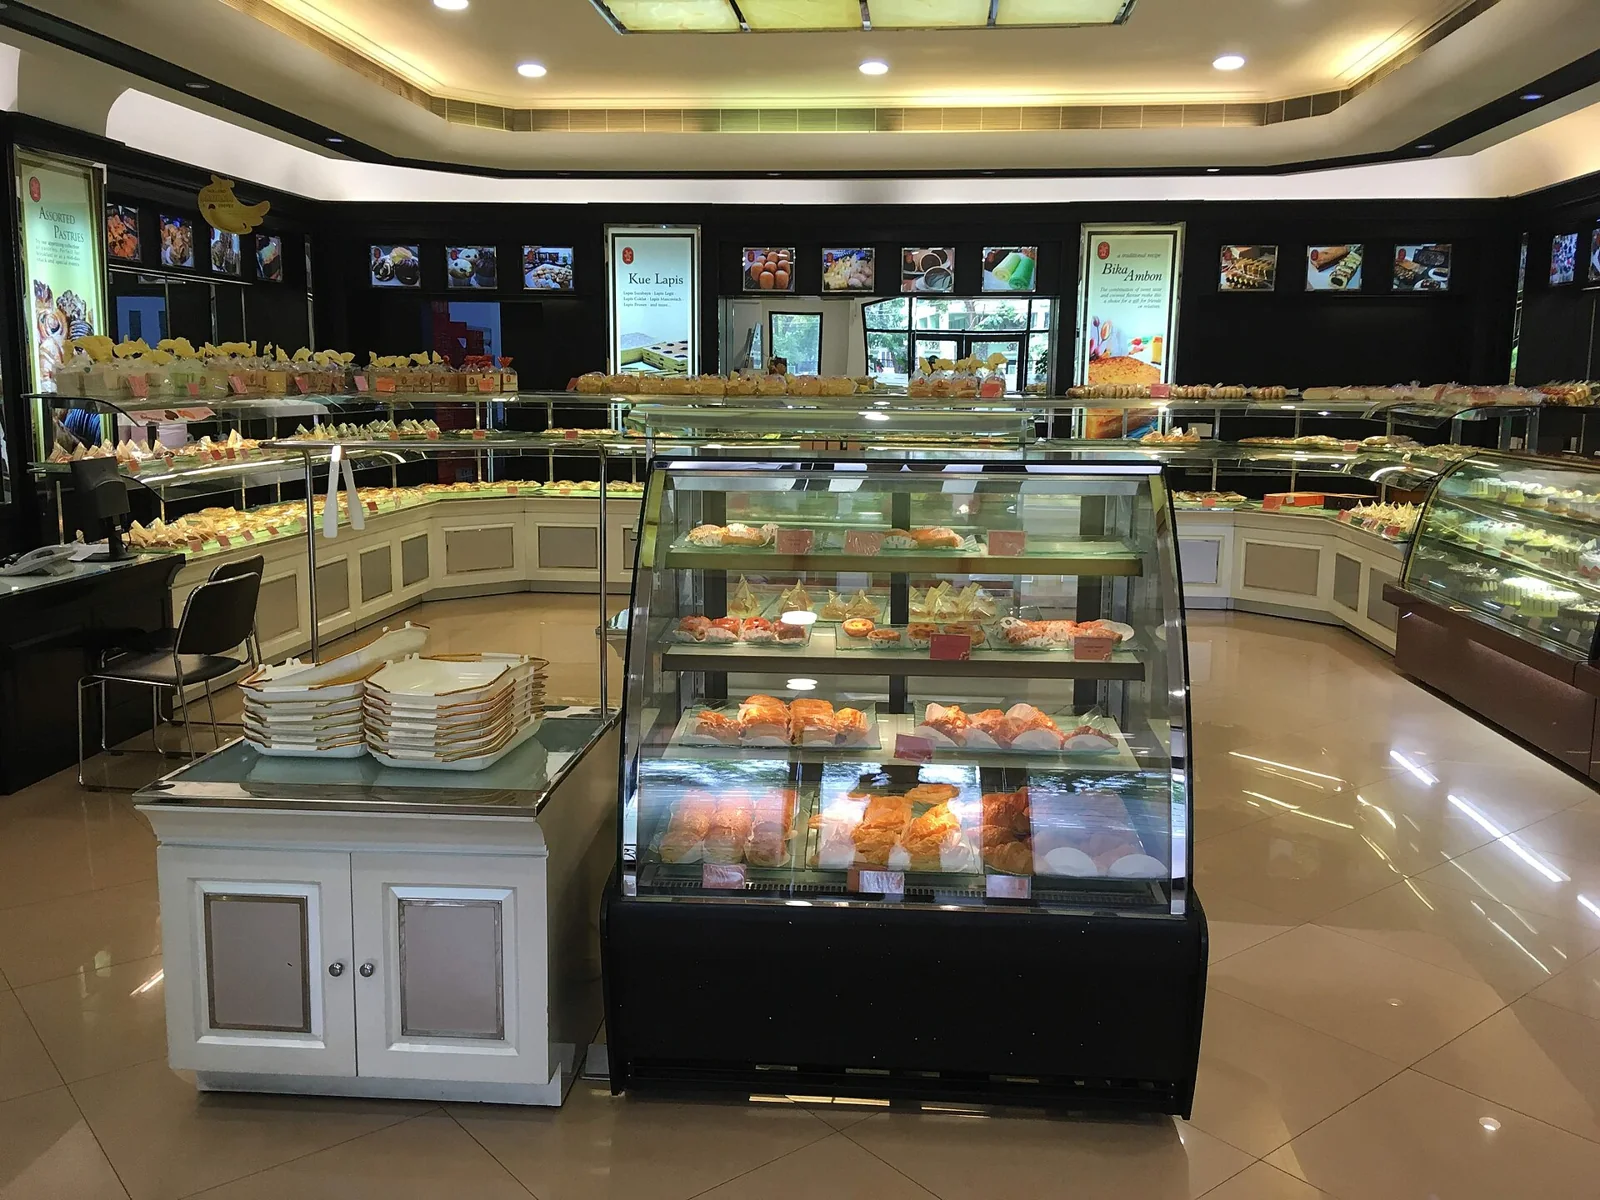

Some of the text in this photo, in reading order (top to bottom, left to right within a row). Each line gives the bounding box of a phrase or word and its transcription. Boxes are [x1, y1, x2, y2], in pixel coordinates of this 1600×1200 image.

[39, 206, 76, 224] ASSORTED
[54, 225, 84, 243] PASTRIES
[628, 272, 684, 287] Kue Lapis
[1101, 262, 1162, 281] Bika Ambon
